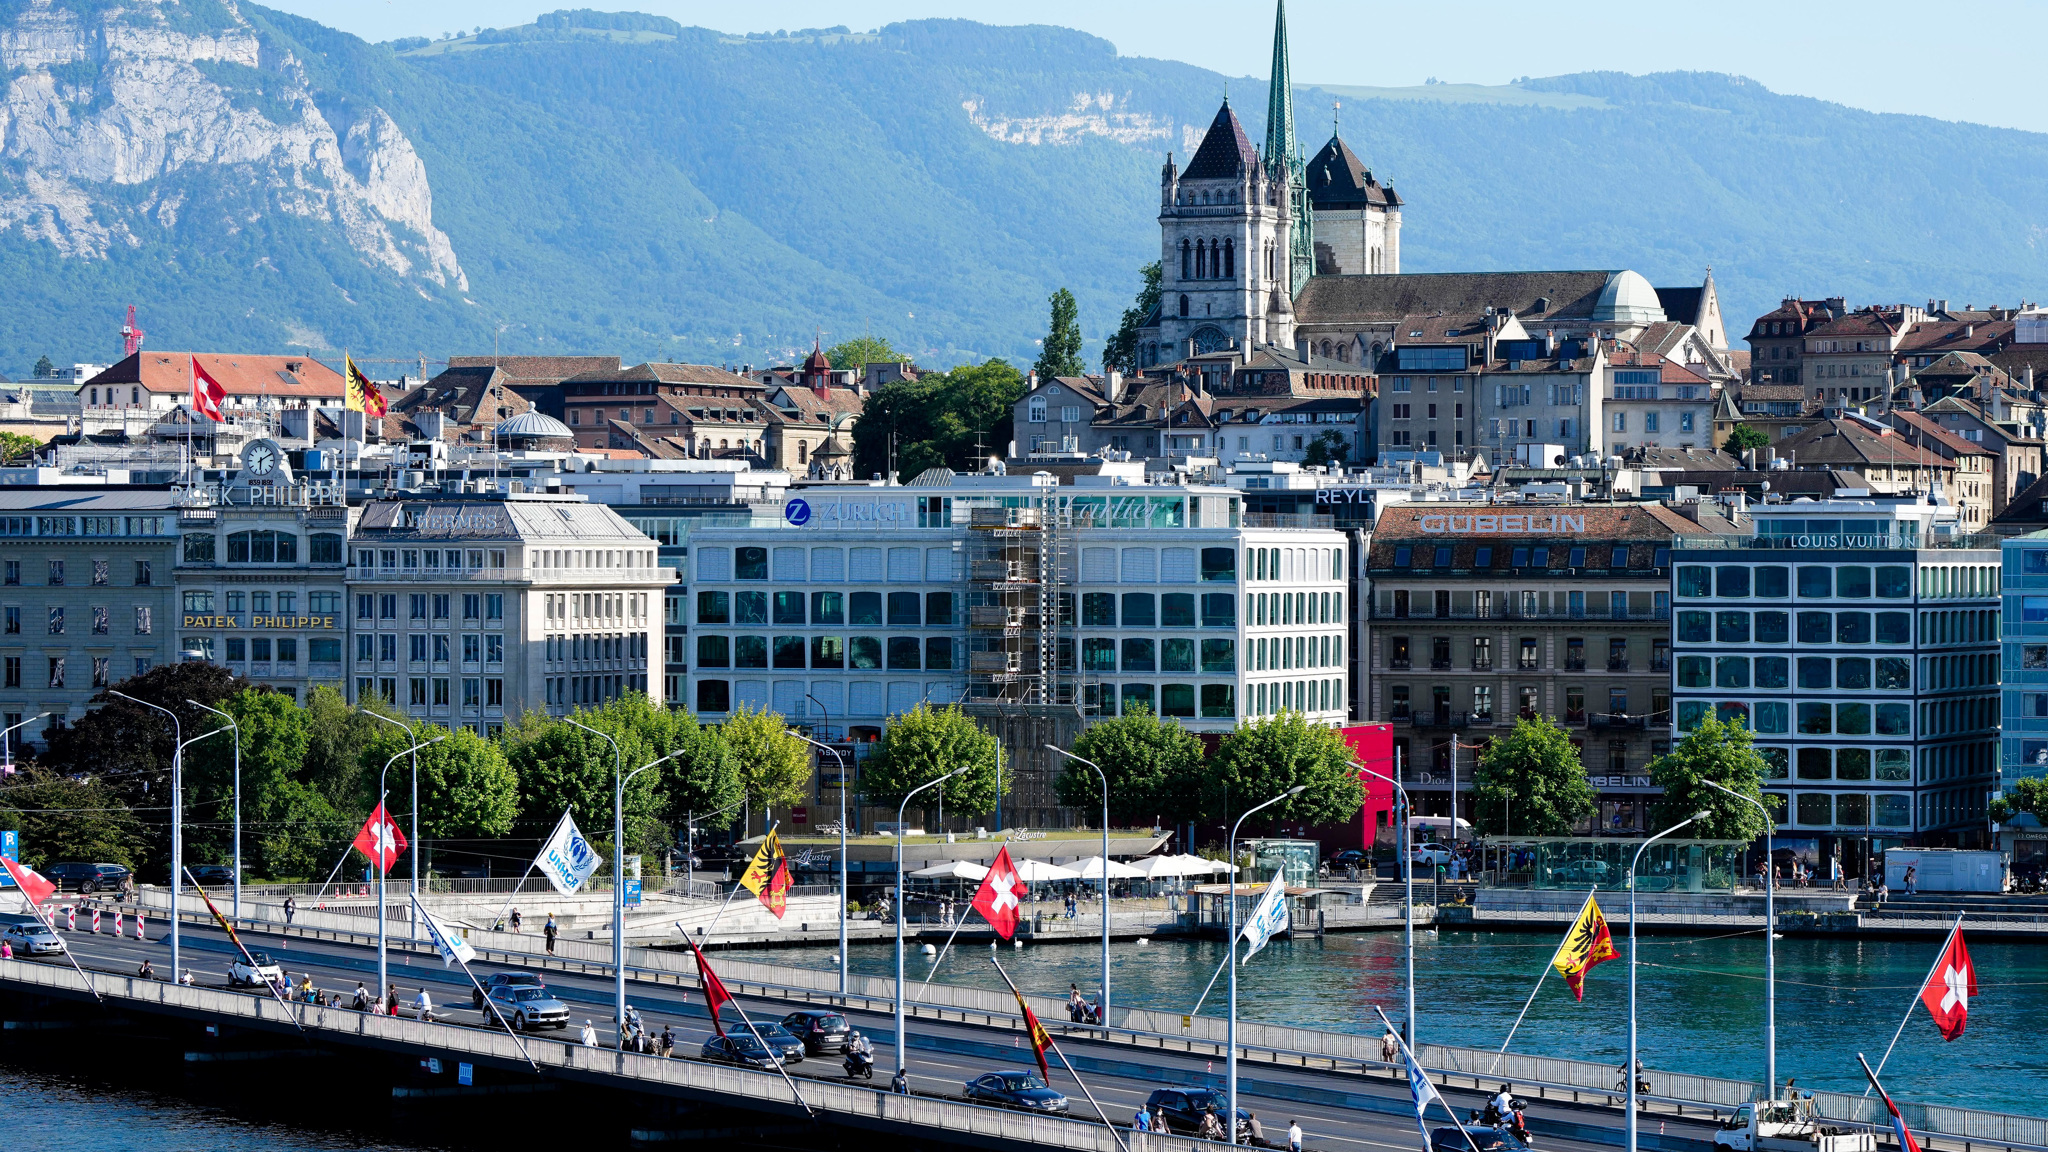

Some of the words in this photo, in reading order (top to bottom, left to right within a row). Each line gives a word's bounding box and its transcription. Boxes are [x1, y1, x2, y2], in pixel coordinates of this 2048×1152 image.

[170, 485, 234, 506] PATEK
[251, 485, 343, 506] PHILIPPE
[1316, 489, 1370, 504] REYL
[820, 503, 905, 521] ZURICH
[1064, 494, 1165, 519] Cartier
[1420, 515, 1584, 533] GÜBELIN
[1791, 535, 1837, 548] LOUIS
[1846, 535, 1916, 548] VUITTON
[184, 616, 237, 628] PATEK
[253, 616, 333, 628] PHILIPPE
[1420, 772, 1446, 785] Dior
[1015, 828, 1047, 840] Lacustre
[549, 849, 579, 889] UNHCR
